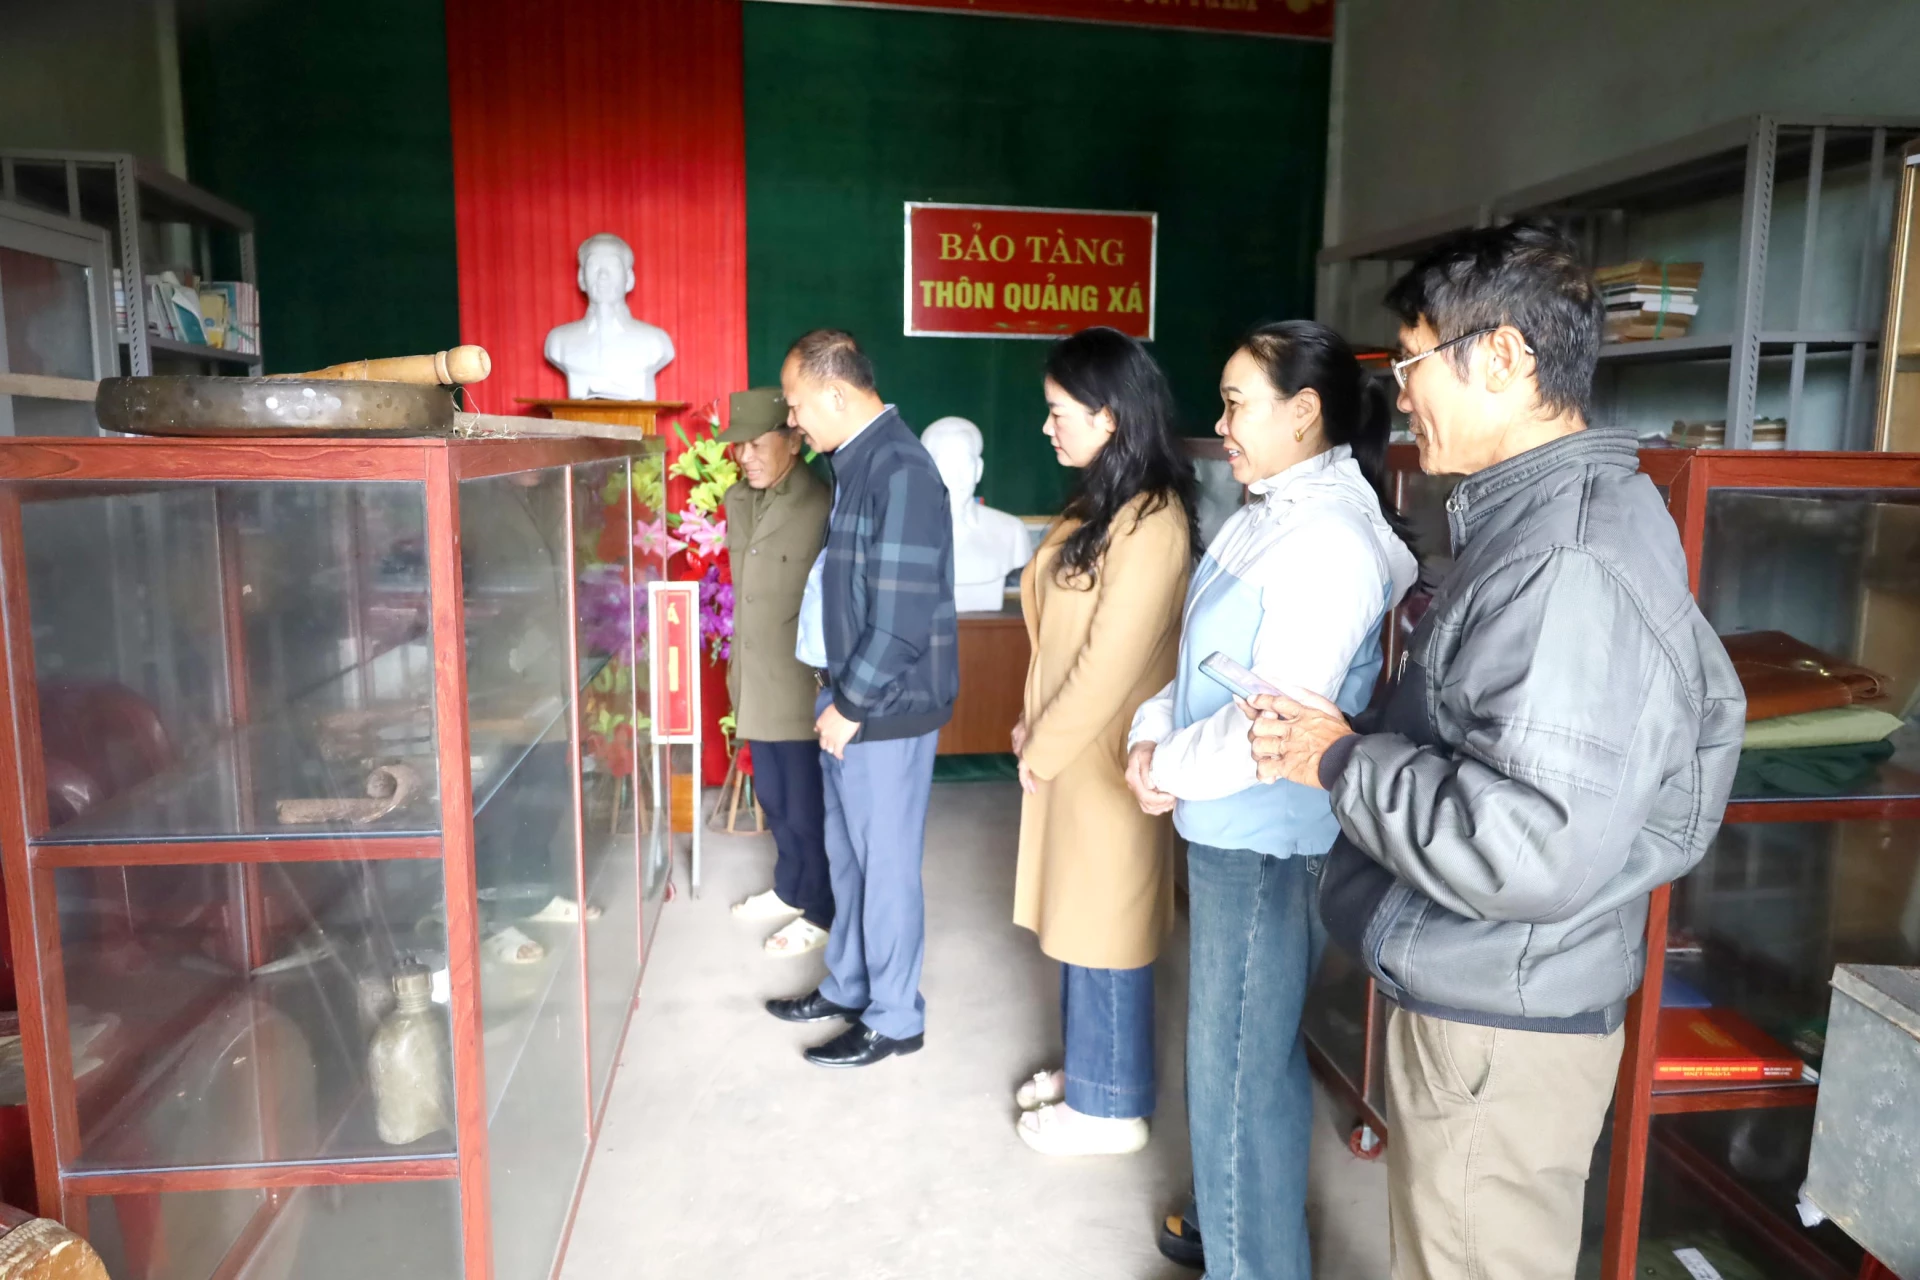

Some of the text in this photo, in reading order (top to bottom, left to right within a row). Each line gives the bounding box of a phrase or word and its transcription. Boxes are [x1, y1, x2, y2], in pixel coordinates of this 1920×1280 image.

[938, 222, 1126, 266] BẢO TÀNG
[919, 273, 1144, 314] THÔN QUẢNG XÁ
